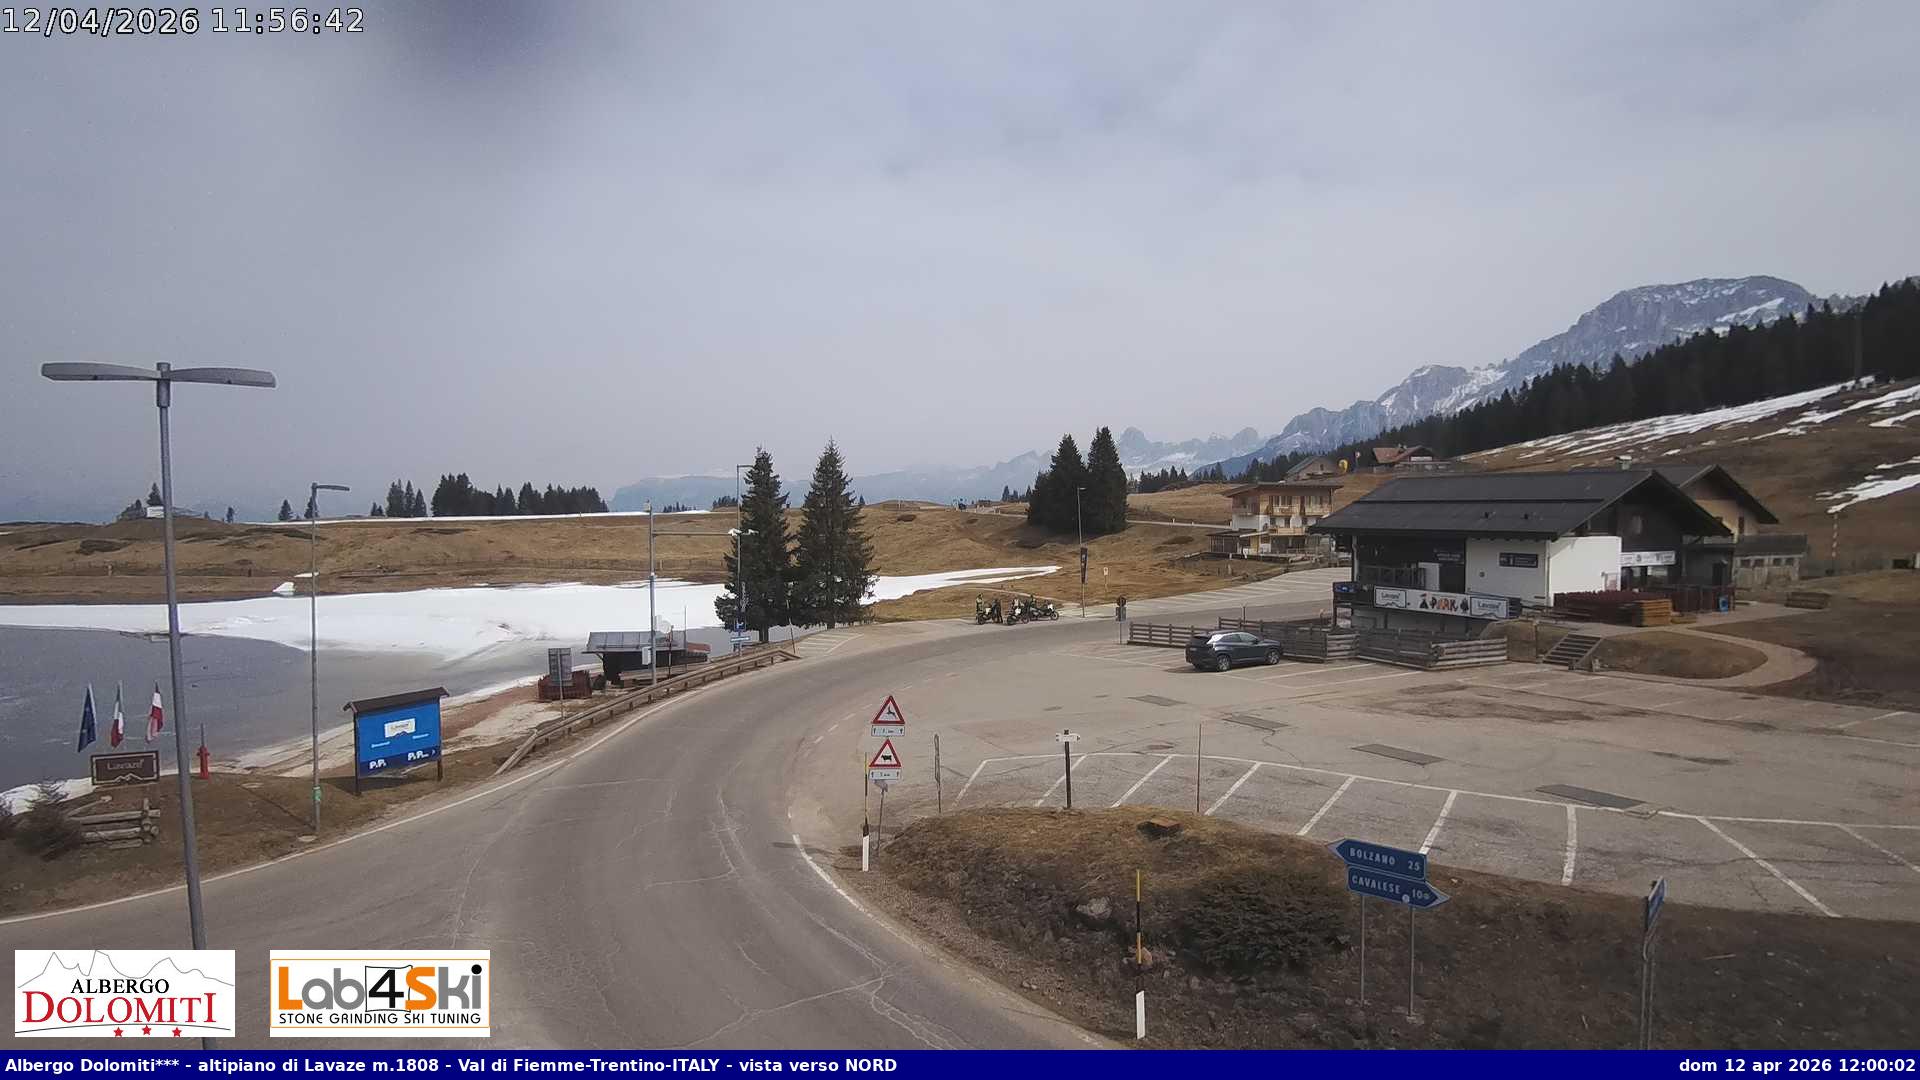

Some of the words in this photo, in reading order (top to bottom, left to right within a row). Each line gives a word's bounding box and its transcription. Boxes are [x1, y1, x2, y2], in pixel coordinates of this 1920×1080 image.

[1349, 847, 1396, 866] BOLZANO
[1407, 860, 1421, 872] 25
[1351, 874, 1402, 895] CAVALESE
